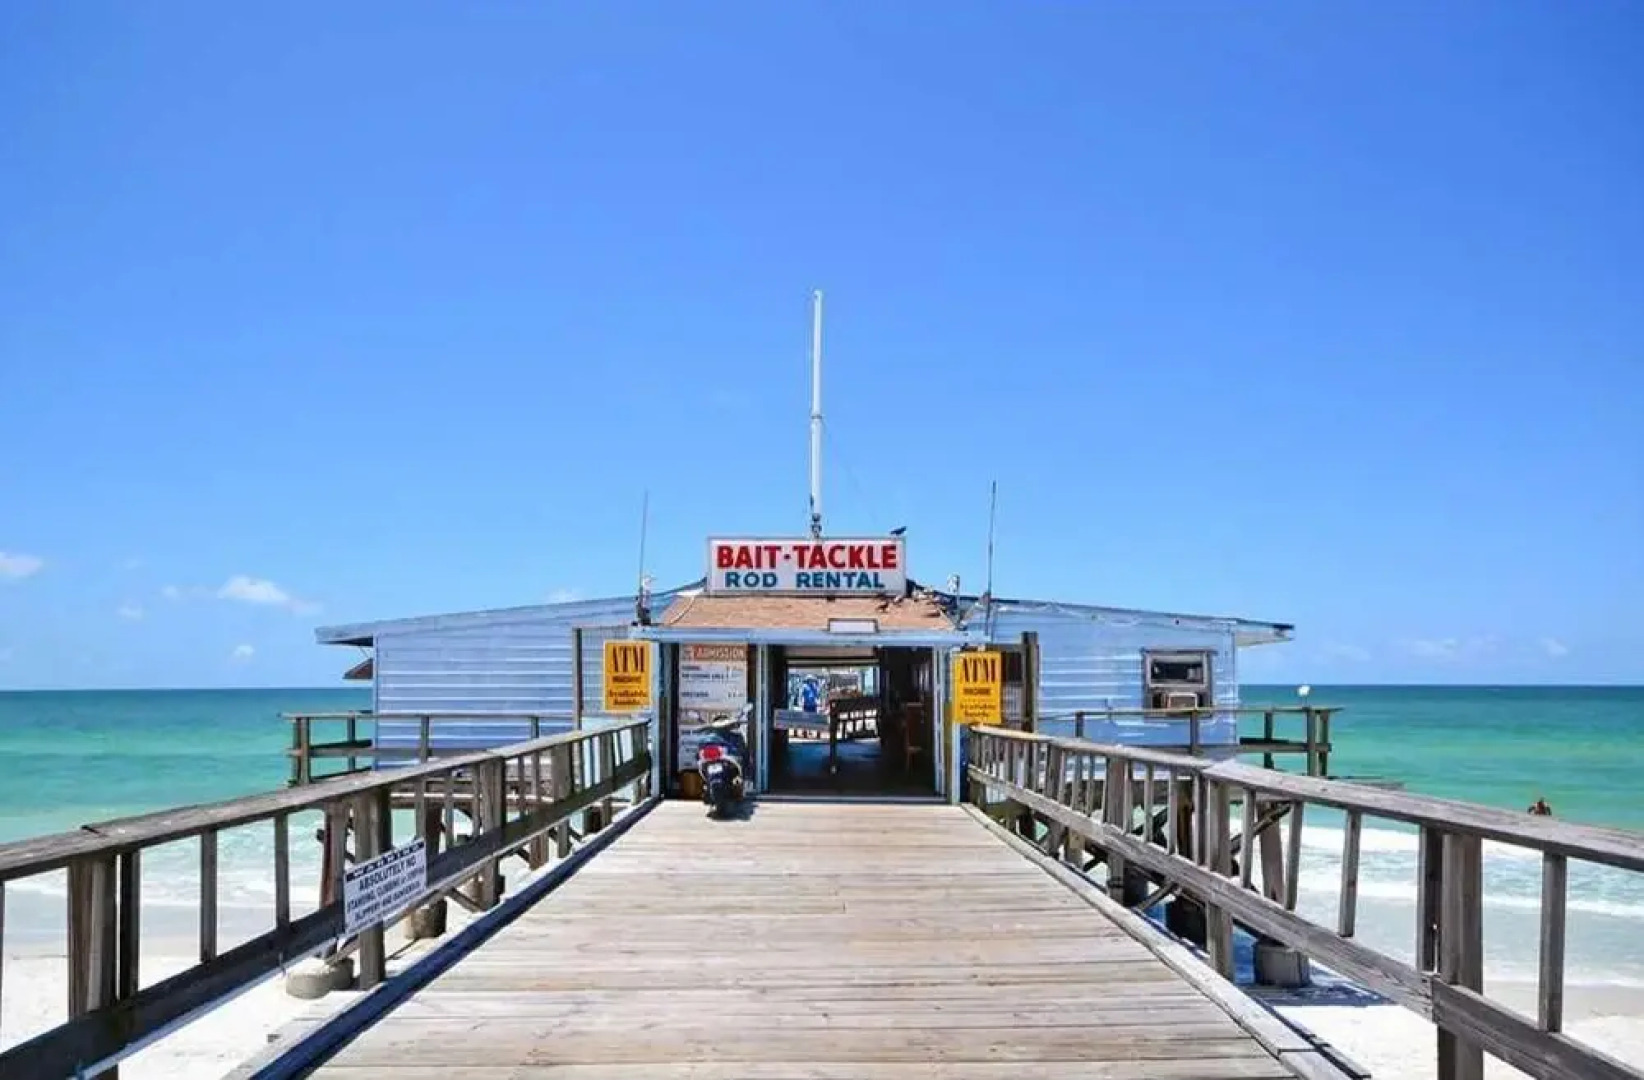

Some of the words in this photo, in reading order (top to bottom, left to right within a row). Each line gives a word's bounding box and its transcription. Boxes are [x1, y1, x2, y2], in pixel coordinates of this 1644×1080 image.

[724, 572, 777, 588] ROD
[796, 572, 885, 588] RENTAL
[610, 646, 645, 673] ATM
[960, 658, 996, 683] ATM
[359, 860, 405, 890] ABSOLUTELY
[406, 855, 416, 868] NO
